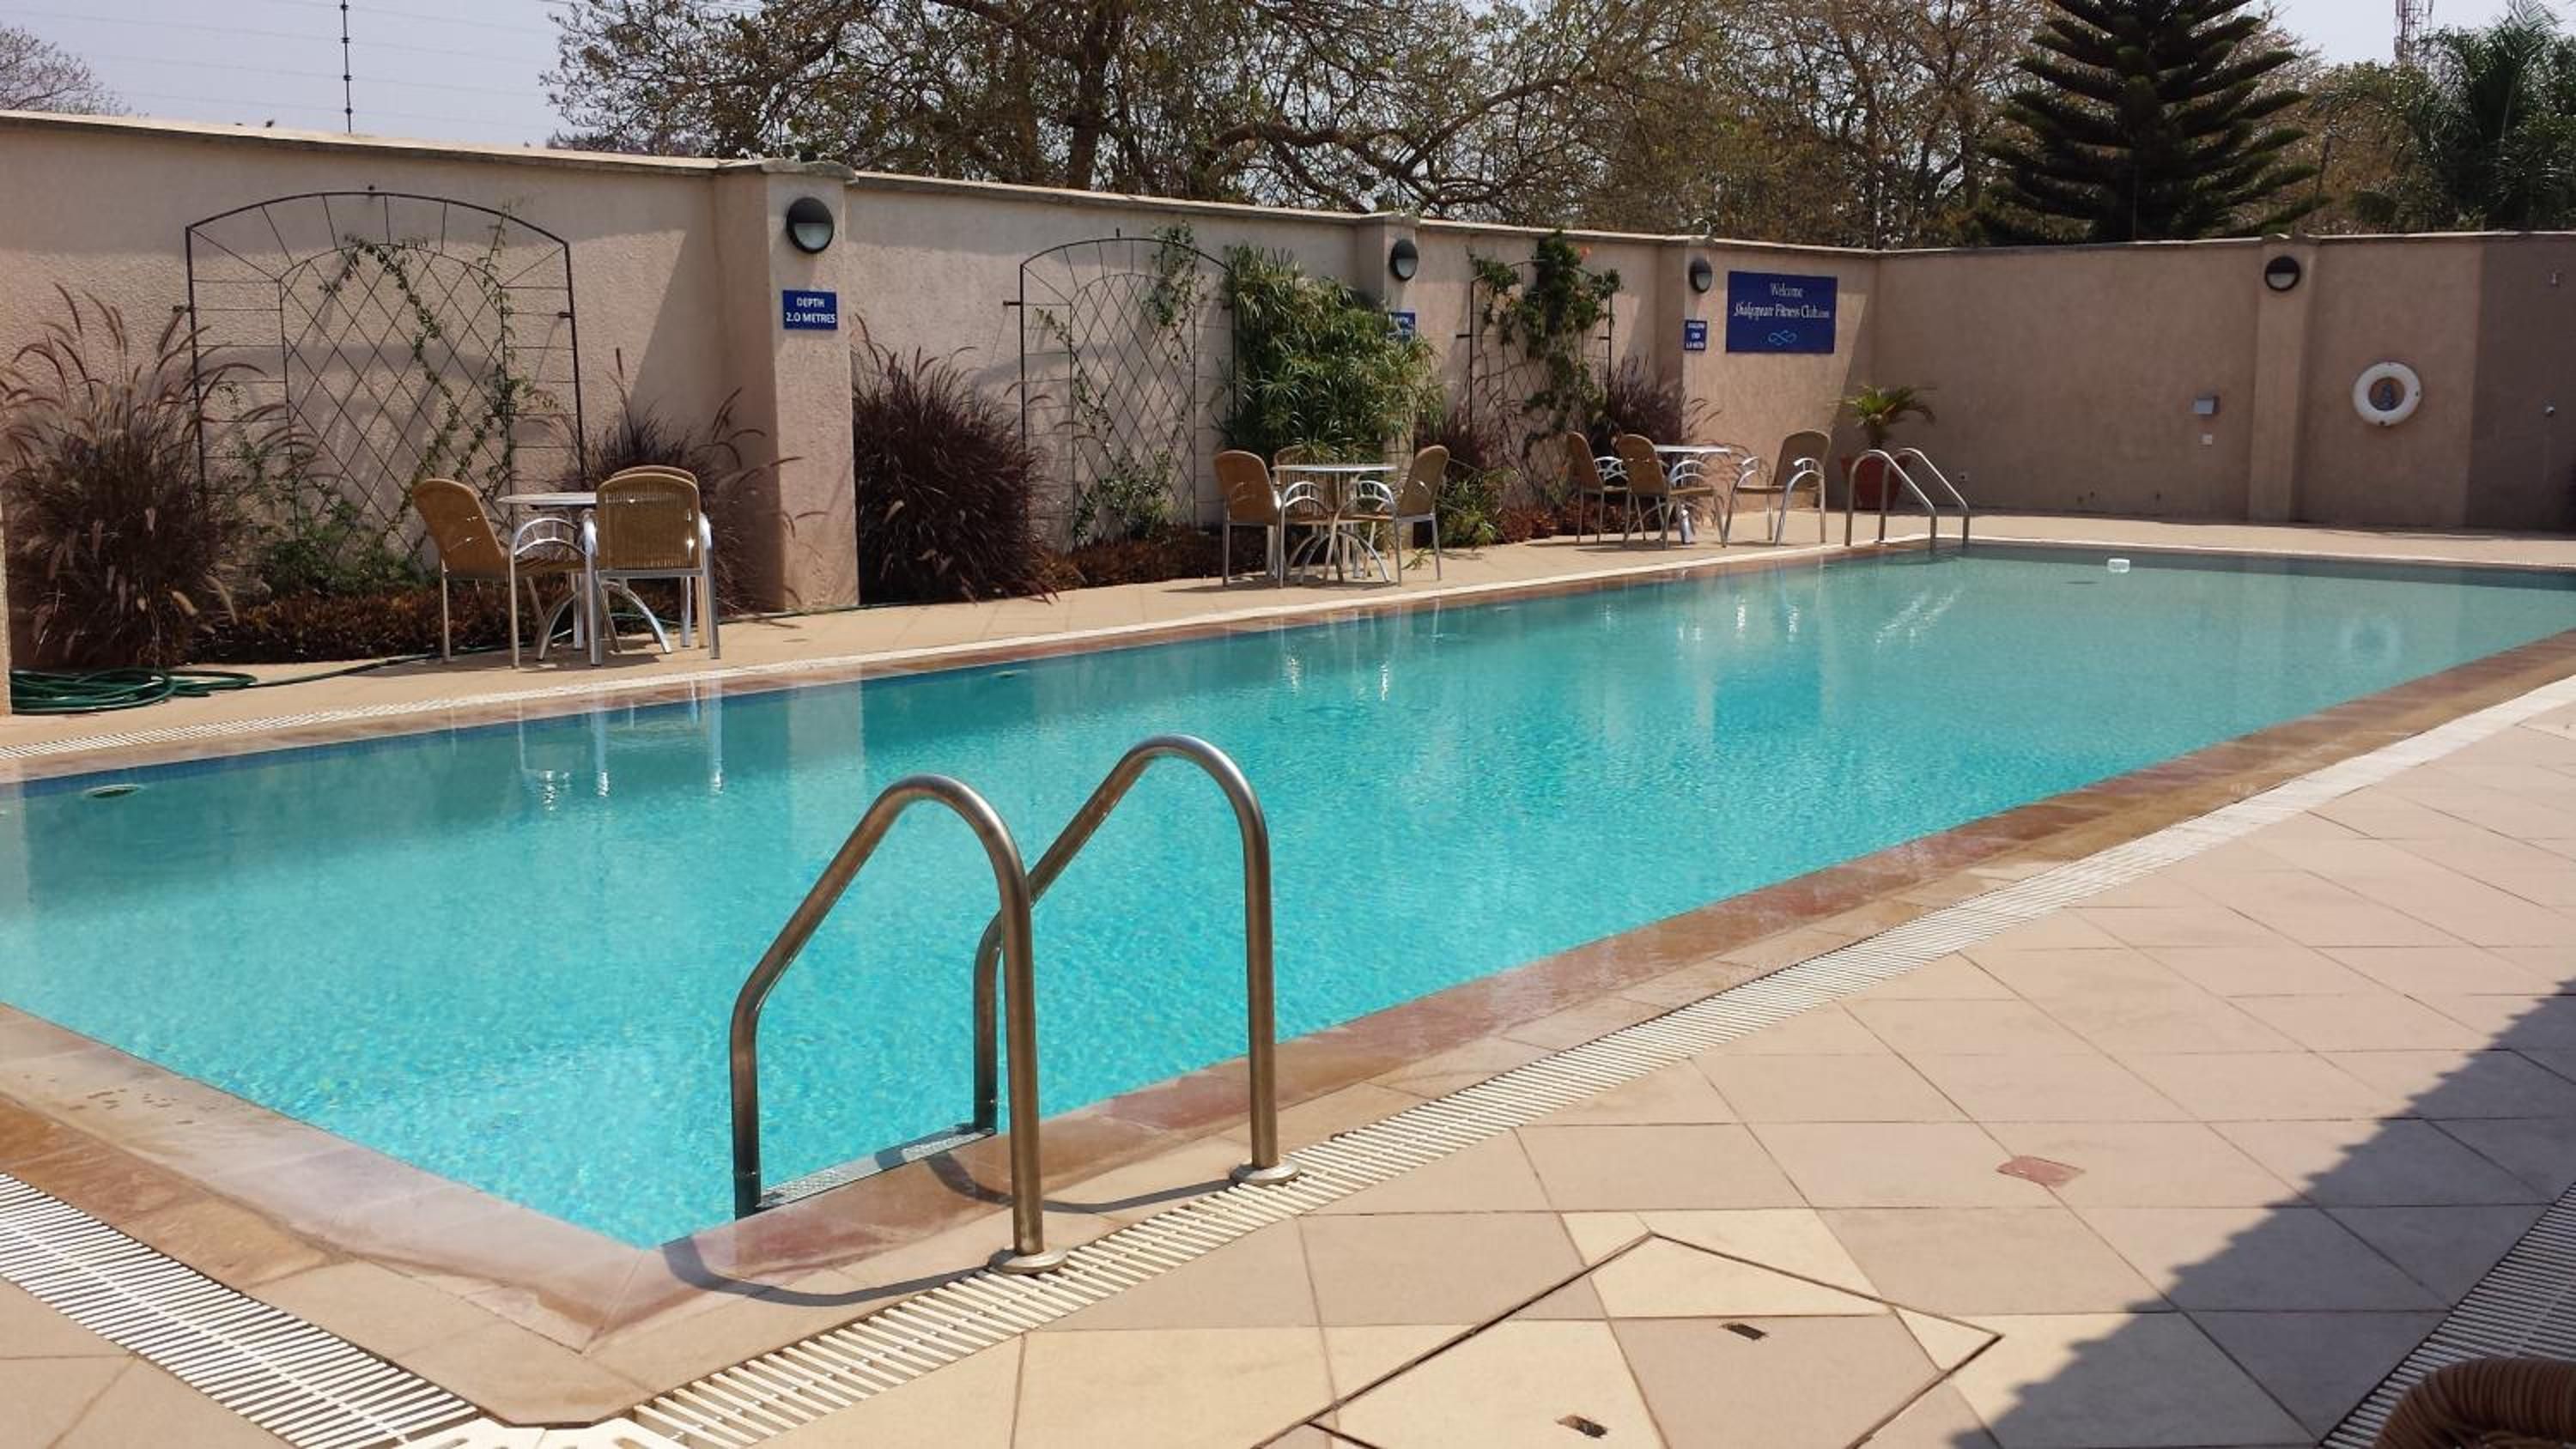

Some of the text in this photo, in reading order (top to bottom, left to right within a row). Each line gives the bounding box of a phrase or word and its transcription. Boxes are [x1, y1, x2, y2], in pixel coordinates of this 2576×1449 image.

[1770, 282, 1803, 298] Welcome
[796, 297, 825, 307] DEPTH
[1775, 303, 1801, 318] Fitness
[802, 312, 835, 324] METRES
